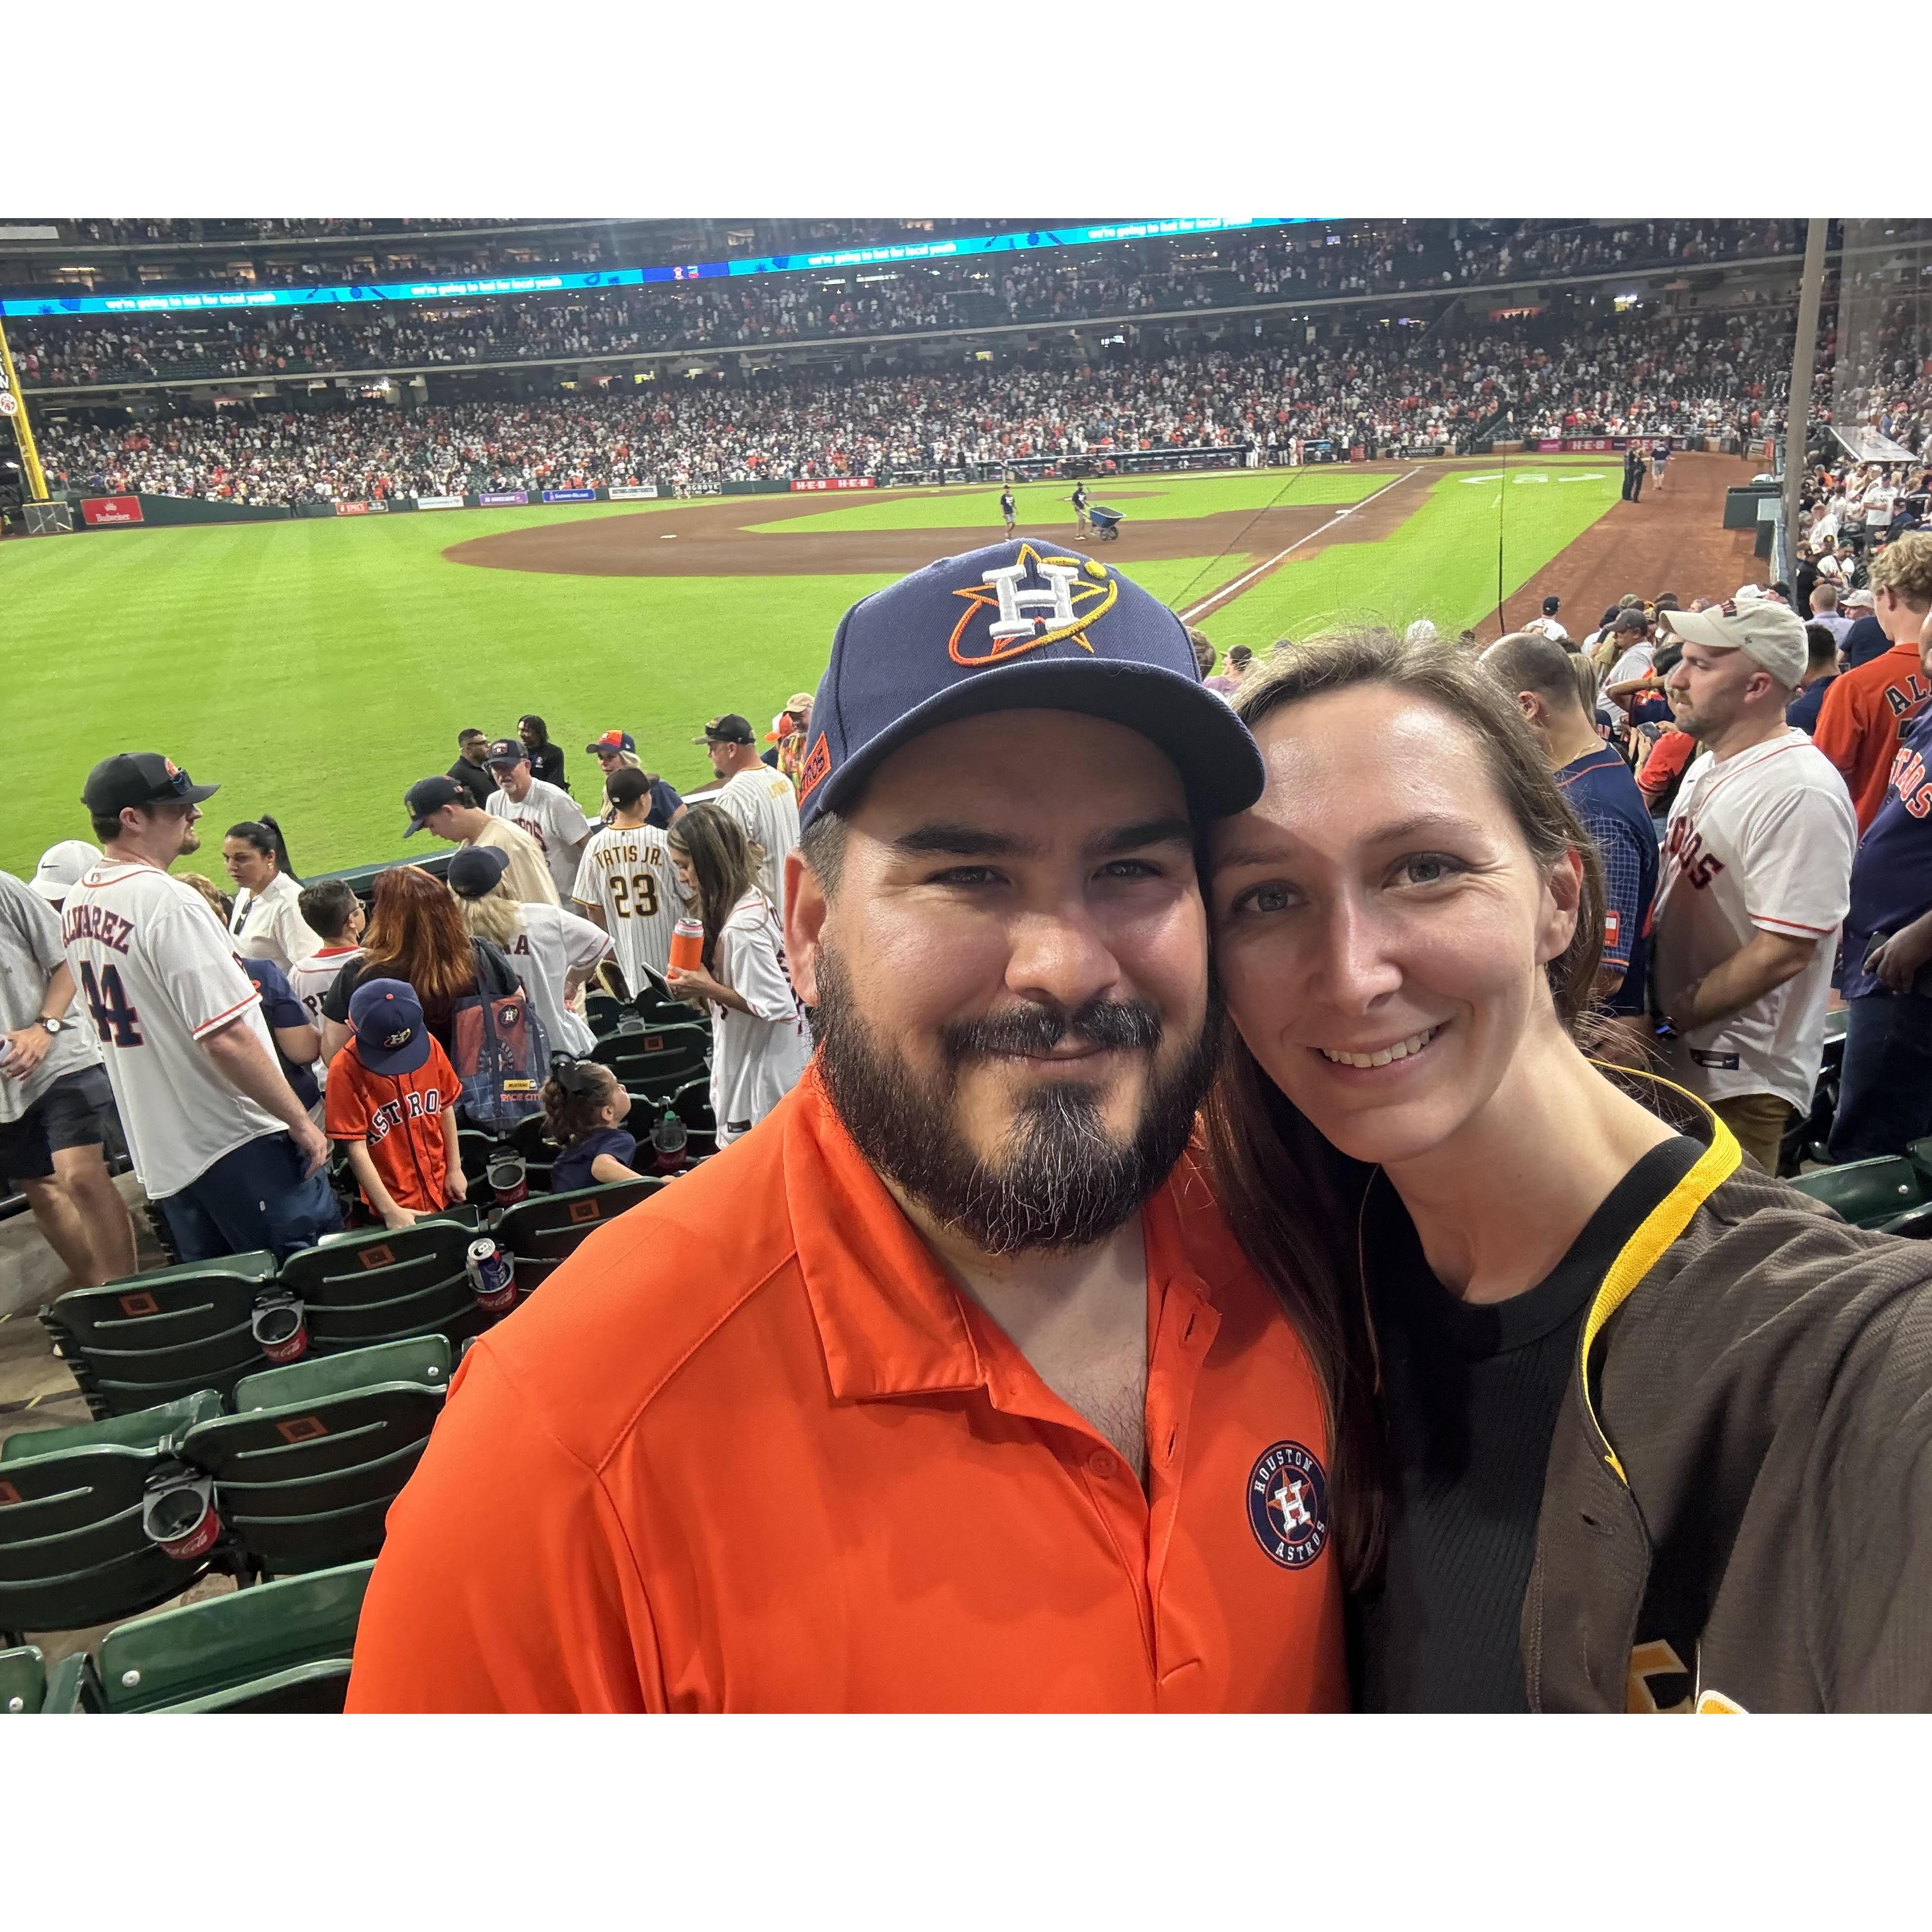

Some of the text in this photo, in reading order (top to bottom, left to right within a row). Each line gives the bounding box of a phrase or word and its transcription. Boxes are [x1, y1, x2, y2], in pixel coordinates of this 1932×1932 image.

[1885, 674, 1932, 717] AL
[595, 845, 662, 869] TATIS JR.
[609, 874, 658, 919] 23
[79, 961, 144, 1048] 44
[1254, 1449, 1313, 1494] HOUSTON
[1276, 1520, 1326, 1561] ASTROS
